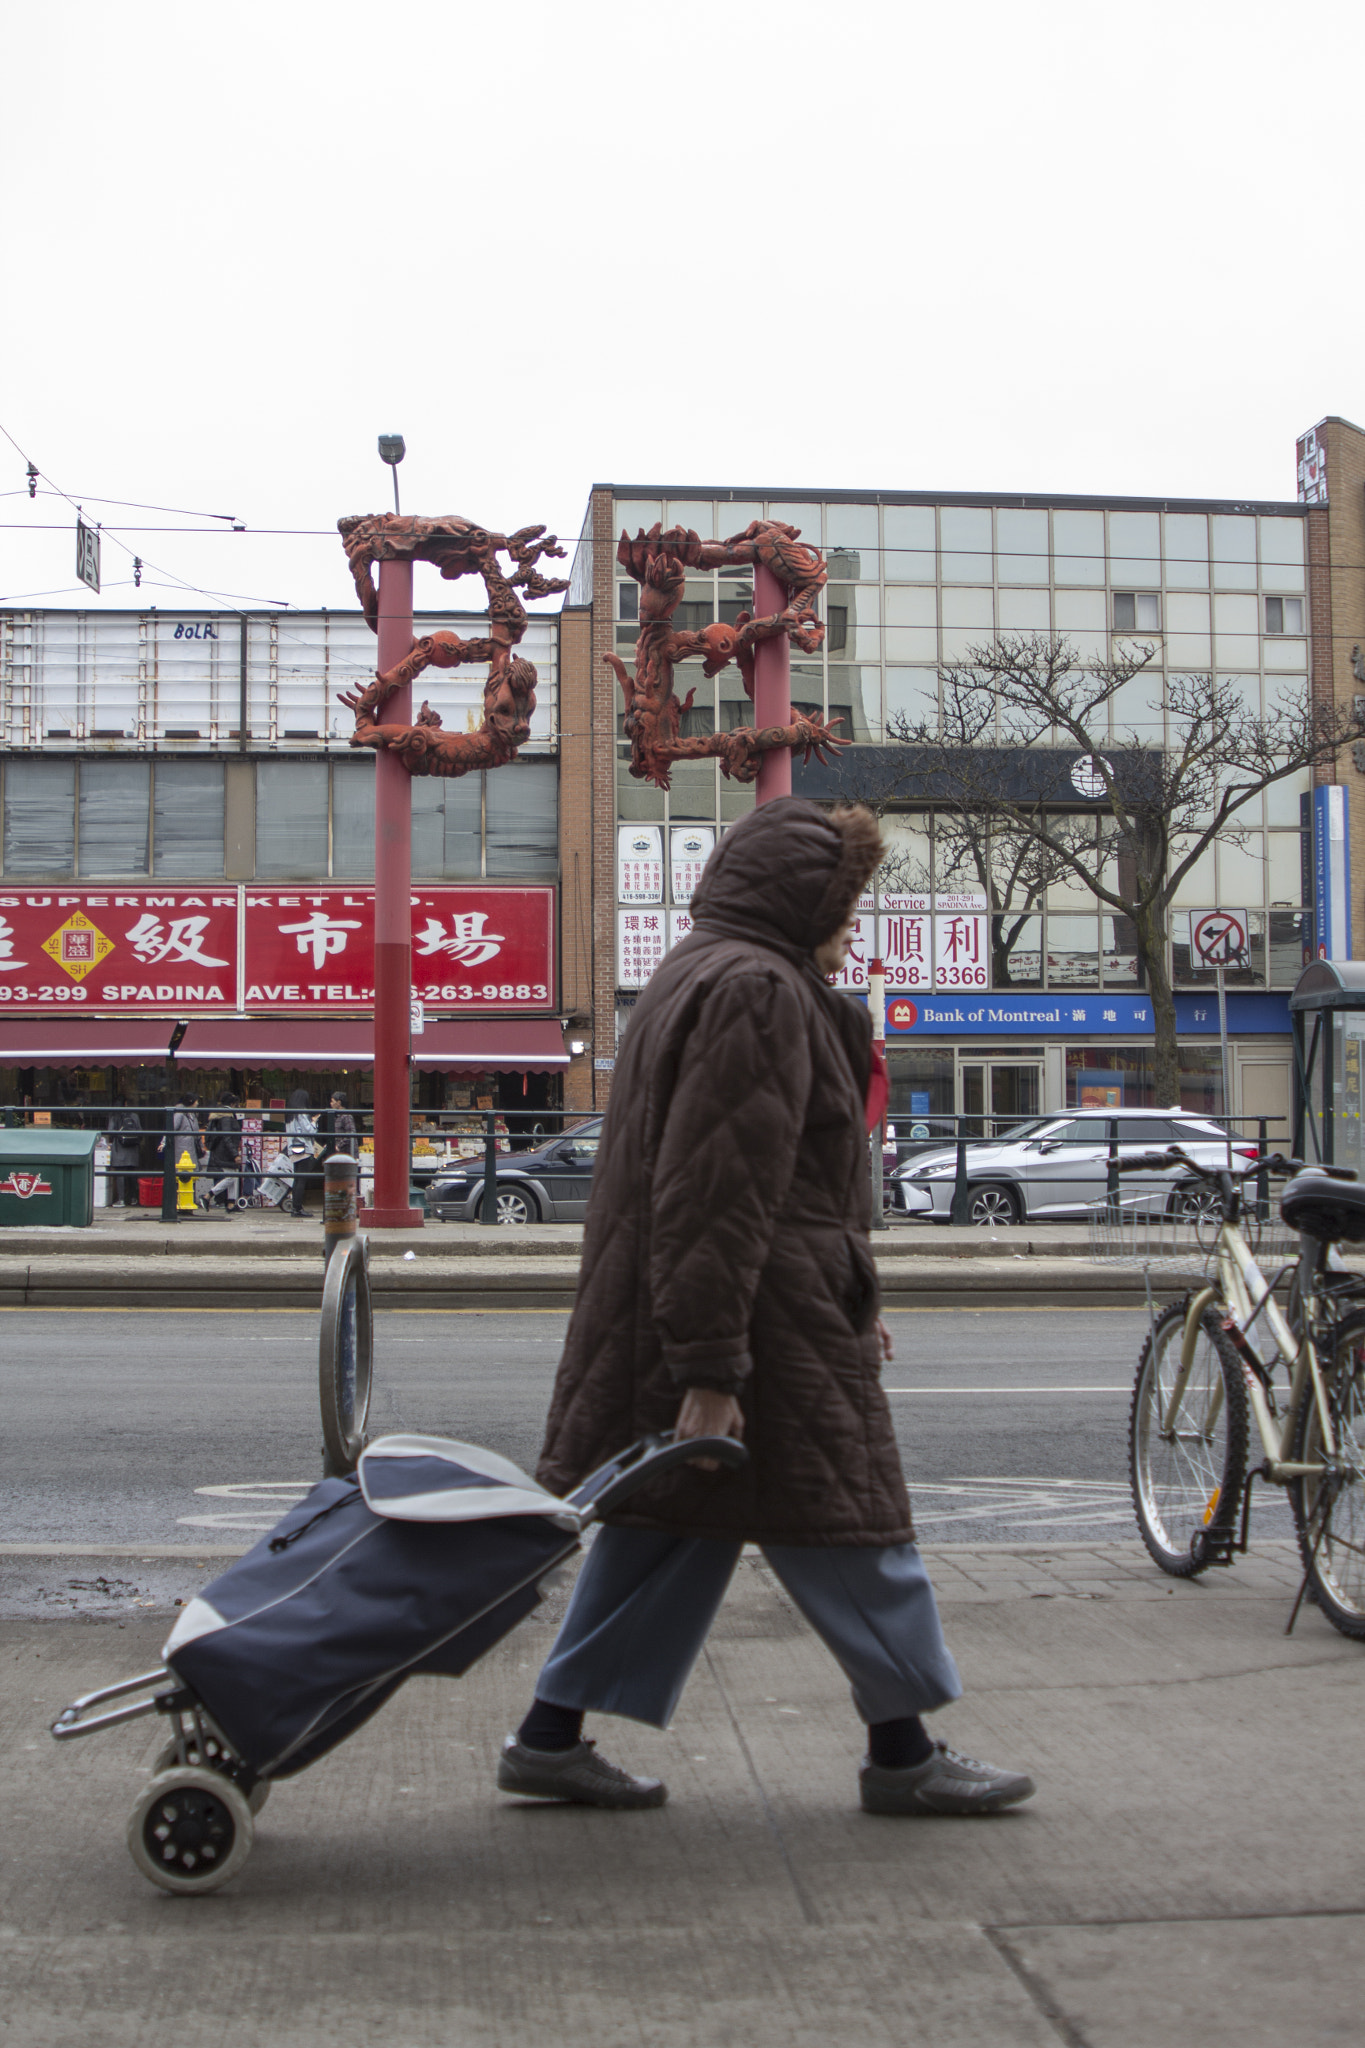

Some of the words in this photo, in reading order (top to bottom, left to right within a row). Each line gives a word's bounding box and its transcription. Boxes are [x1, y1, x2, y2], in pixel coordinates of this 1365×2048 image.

[884, 894, 925, 910] Service
[624, 915, 659, 931] 環球
[102, 985, 224, 1001] SPADINA
[923, 1008, 966, 1022] Bank
[967, 1008, 986, 1022] of
[988, 1008, 1060, 1022] Montreal
